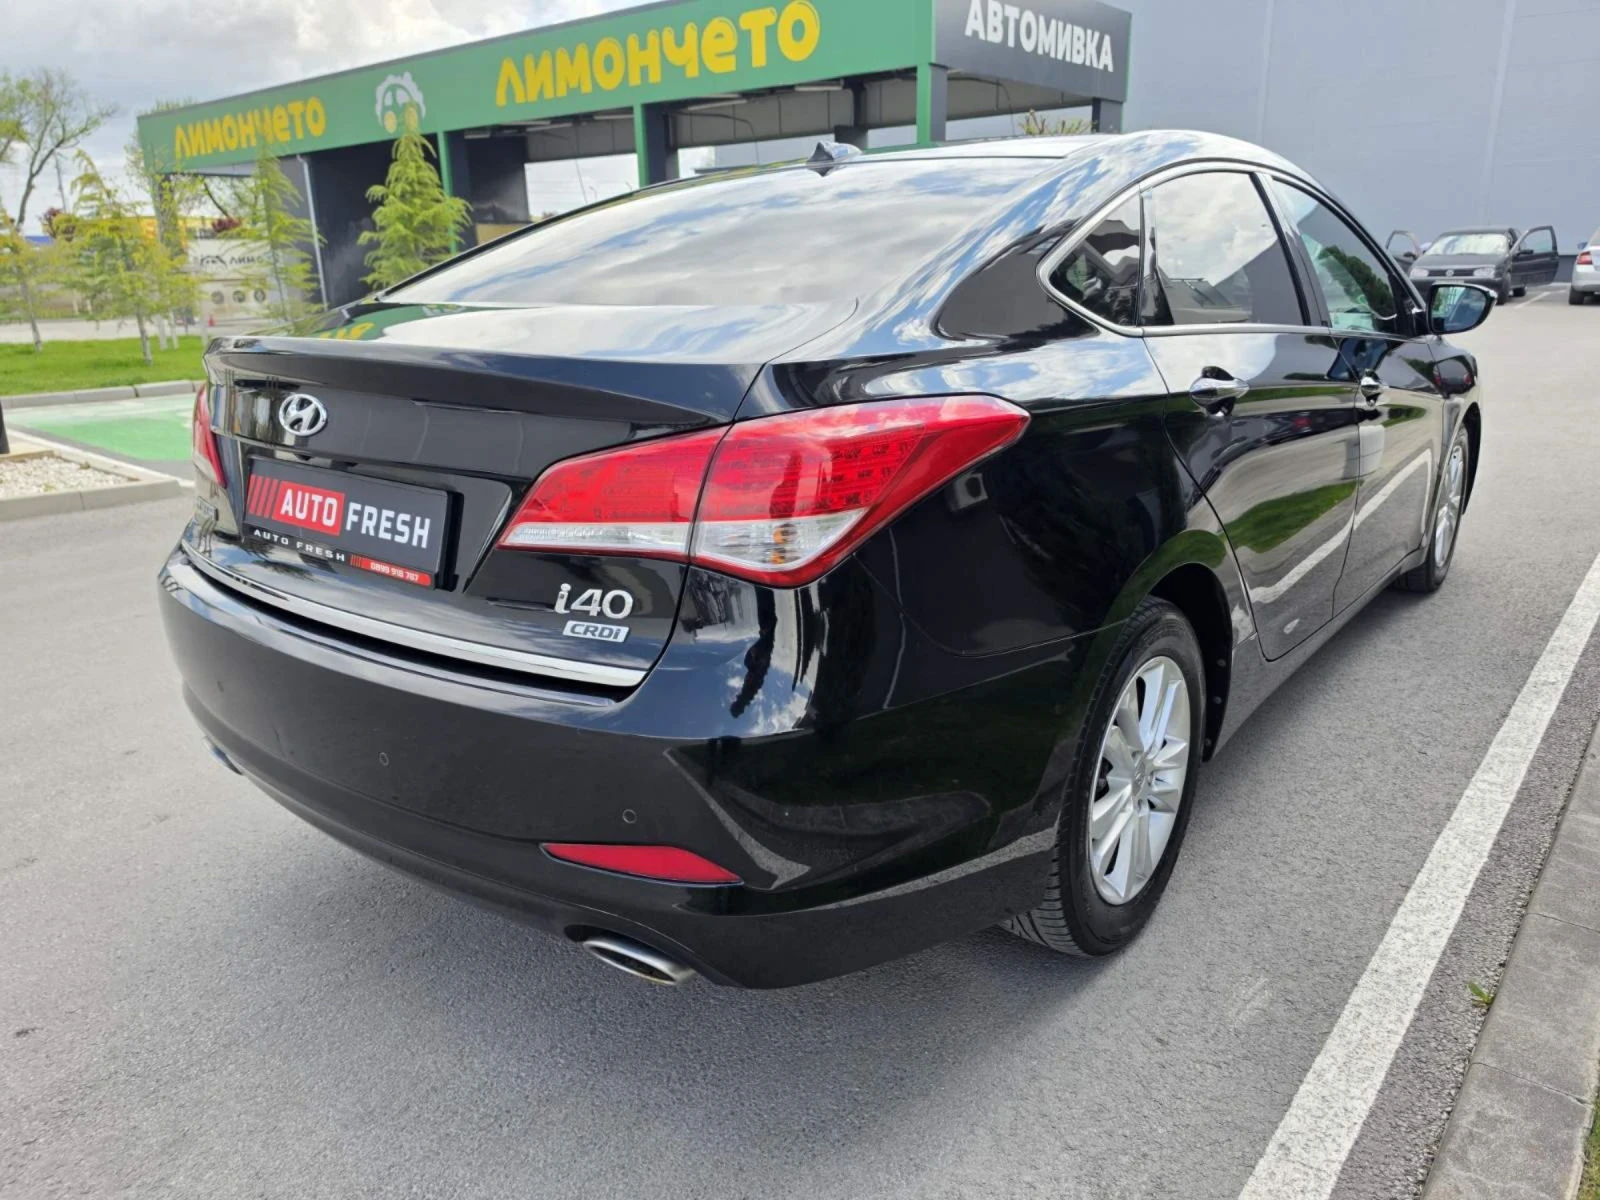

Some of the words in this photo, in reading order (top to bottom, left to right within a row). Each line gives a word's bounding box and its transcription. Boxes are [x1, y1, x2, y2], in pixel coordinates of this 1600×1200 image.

[965, 0, 1114, 73] АВТОМИВКА
[280, 488, 338, 527] AUTO
[345, 501, 431, 549] FRESH
[253, 529, 289, 545] AUTO
[296, 541, 345, 562] FRESH
[554, 583, 634, 619] i40
